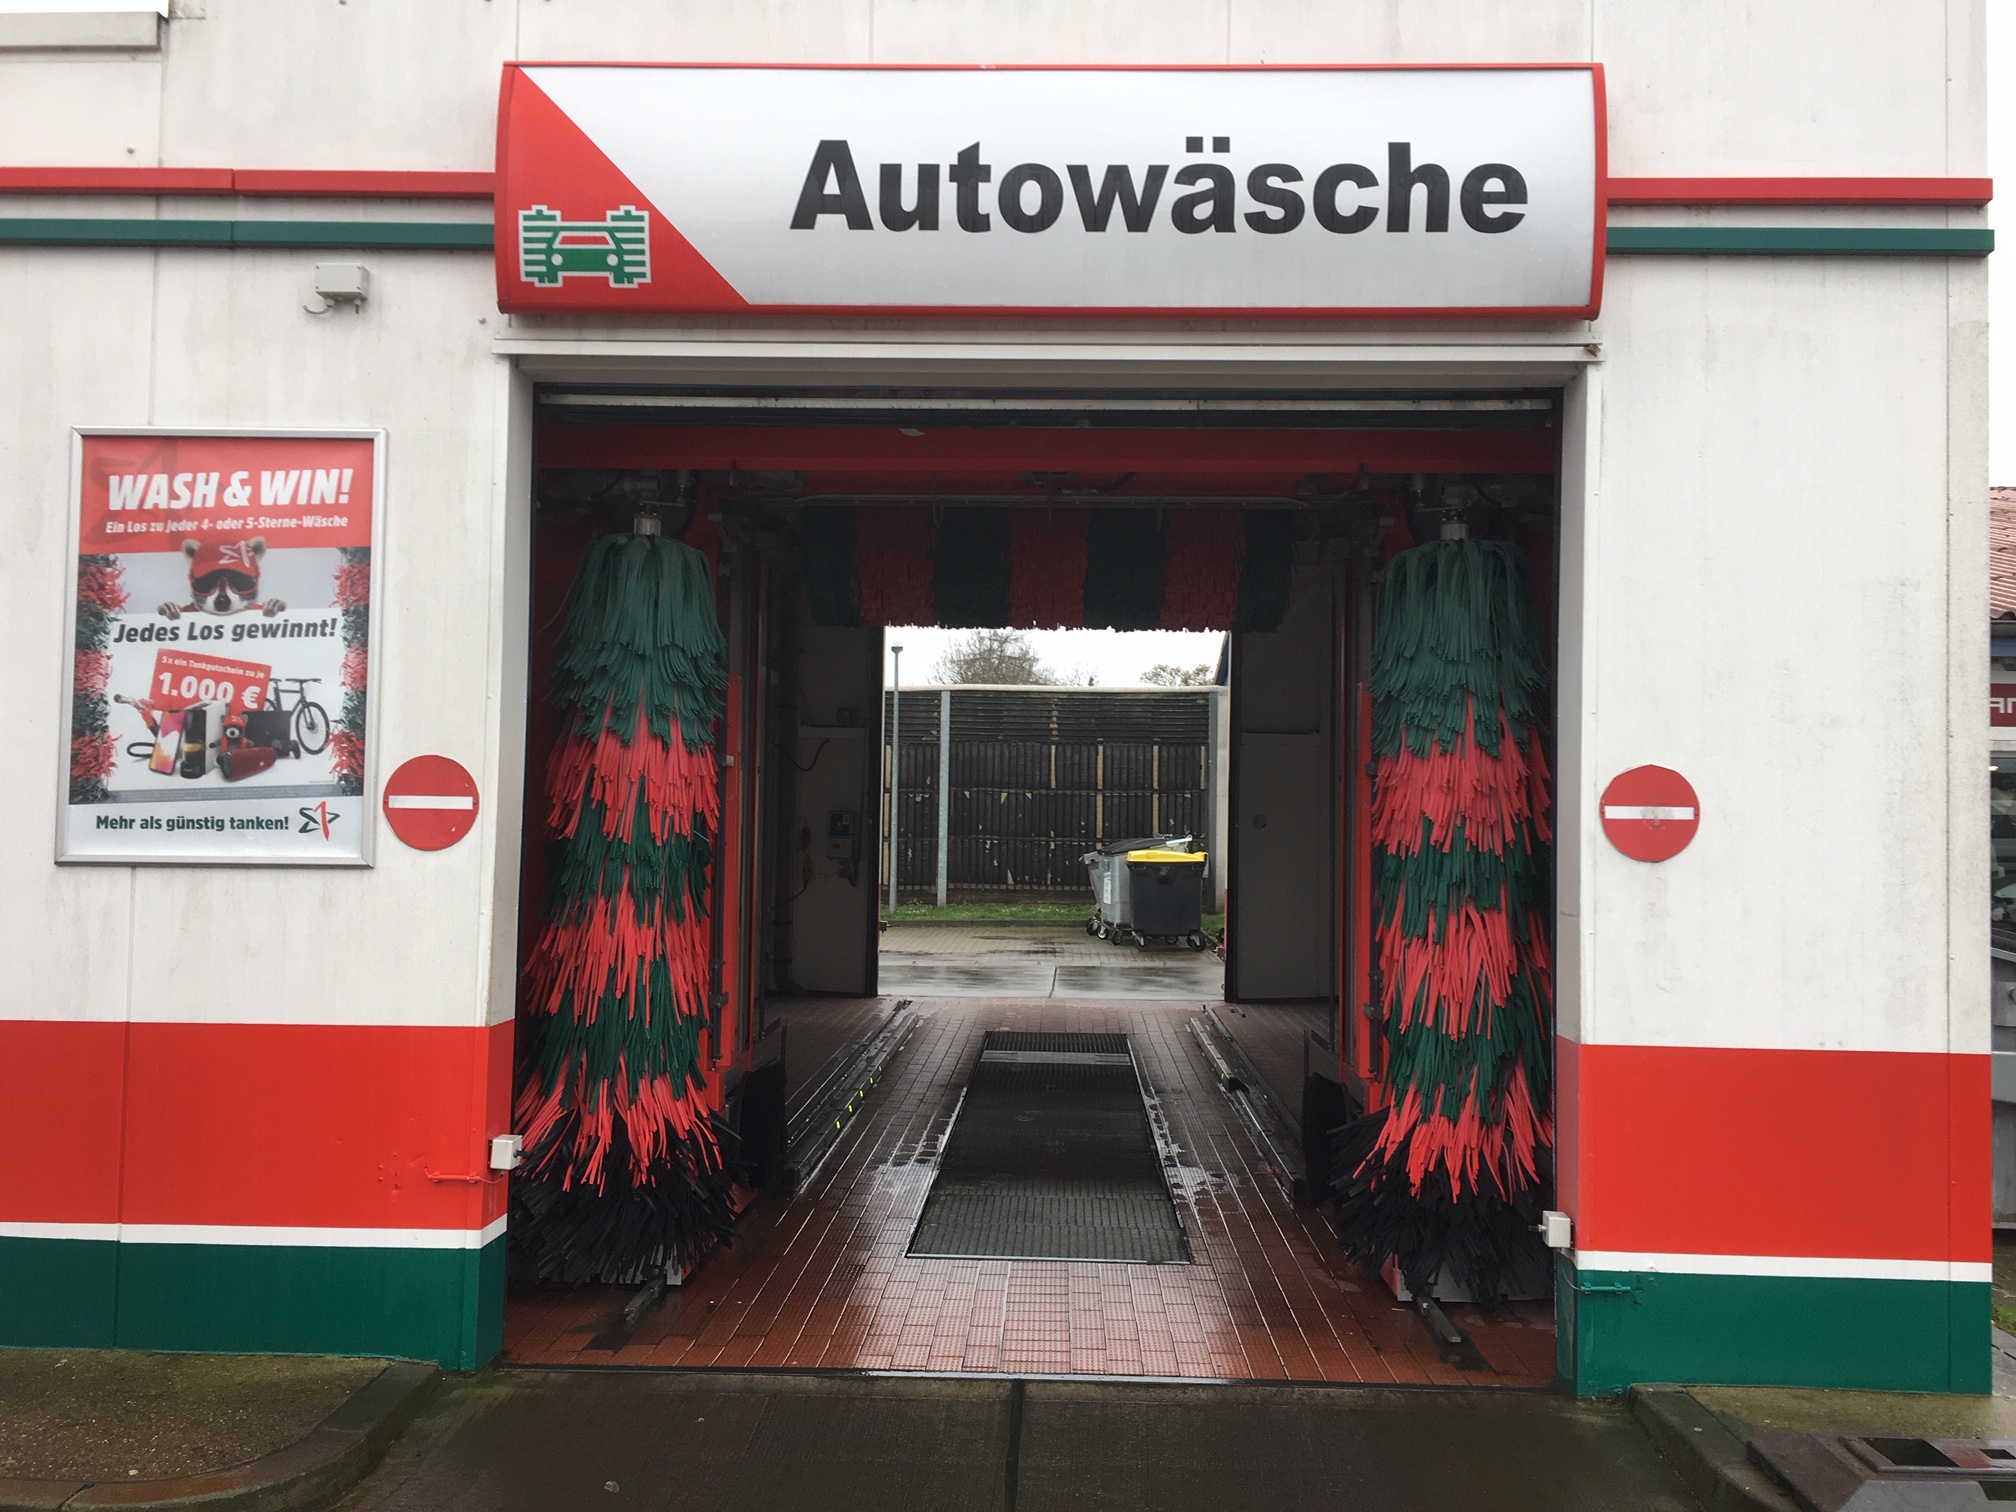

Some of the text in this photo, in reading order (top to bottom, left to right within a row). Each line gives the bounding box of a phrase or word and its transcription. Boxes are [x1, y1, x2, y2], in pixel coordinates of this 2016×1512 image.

[790, 136, 1528, 236] Autowäsche
[108, 468, 353, 511] WASH & WIN!
[105, 514, 348, 534] Ein Los zu jeder 4- oder 5-Sterne-Wäsche
[113, 618, 338, 643] Jedes Los gewinnt!
[161, 655, 265, 679] 5x ein Tankgutschein zu je
[159, 672, 261, 709] 1.000 €
[96, 814, 289, 832] Mehr als günstig tanken!
